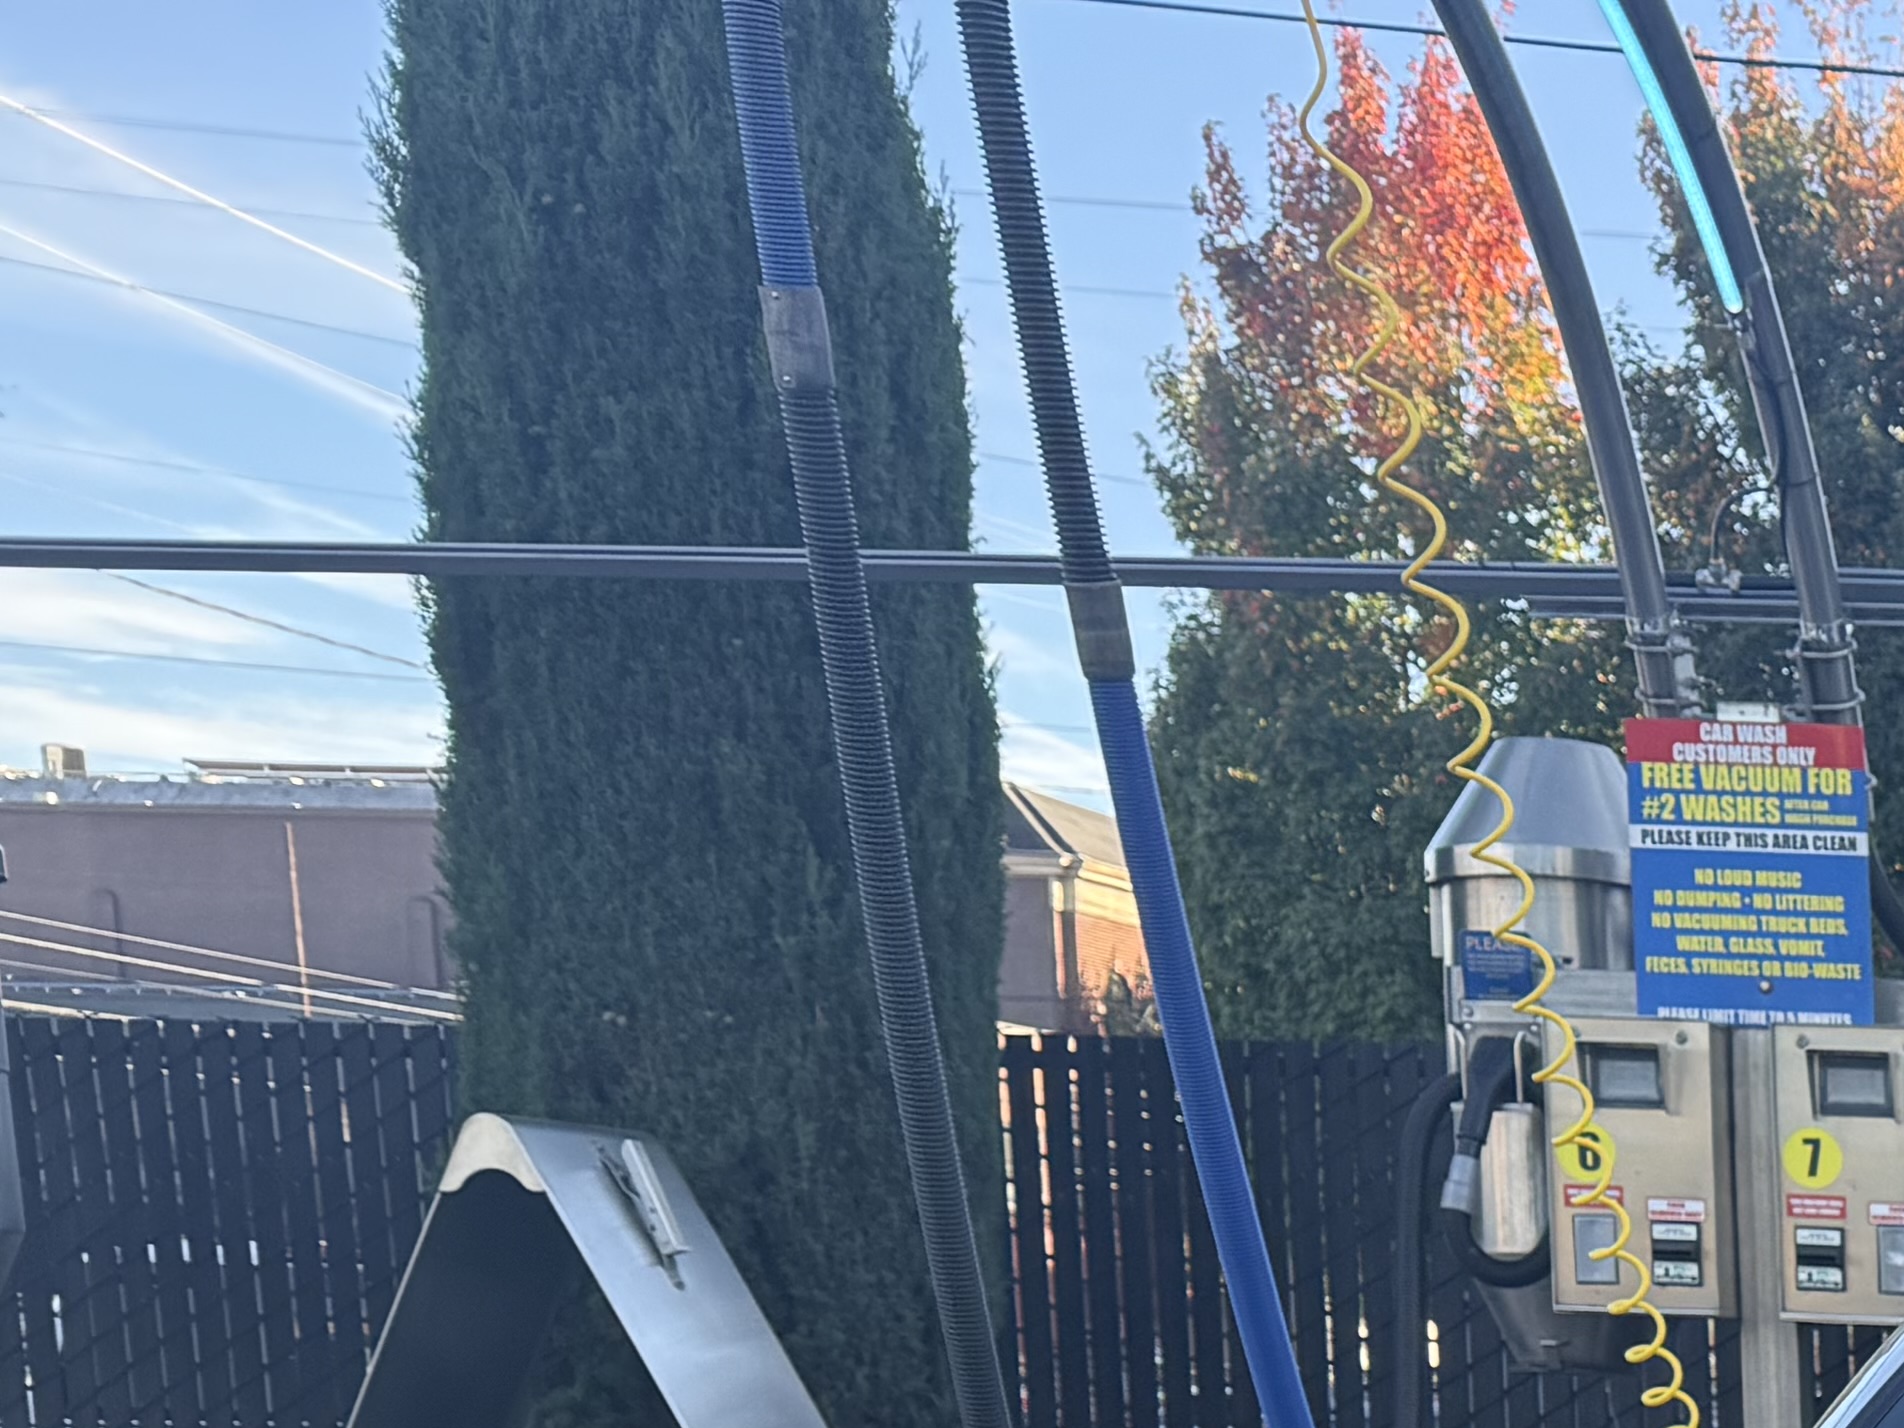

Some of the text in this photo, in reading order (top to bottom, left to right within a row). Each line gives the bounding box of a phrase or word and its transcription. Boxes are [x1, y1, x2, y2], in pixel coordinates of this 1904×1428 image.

[1700, 722, 1787, 744] CAR WASH
[1672, 742, 1816, 766] CUSTOMERS ONLY
[1641, 762, 1853, 795] FREE VACUUM FOR
[1641, 793, 1781, 824] #2 WASHES
[1641, 829, 1857, 852] PLEASE KEEP THIS AREA CLEAN
[1694, 868, 1802, 888] NO LOUD MUSIC
[1654, 889, 1844, 913] NO DUMPING NO LITTERING
[1651, 912, 1671, 929] NO
[1674, 913, 1758, 932] VACUUMING
[1761, 915, 1807, 934] TRUCK
[1691, 958, 1760, 977] SYRINGES
[1762, 960, 1781, 978] OR
[1784, 961, 1862, 981] BIO-WASTE
[1577, 1132, 1601, 1171] 6
[1802, 1138, 1822, 1177] 7
